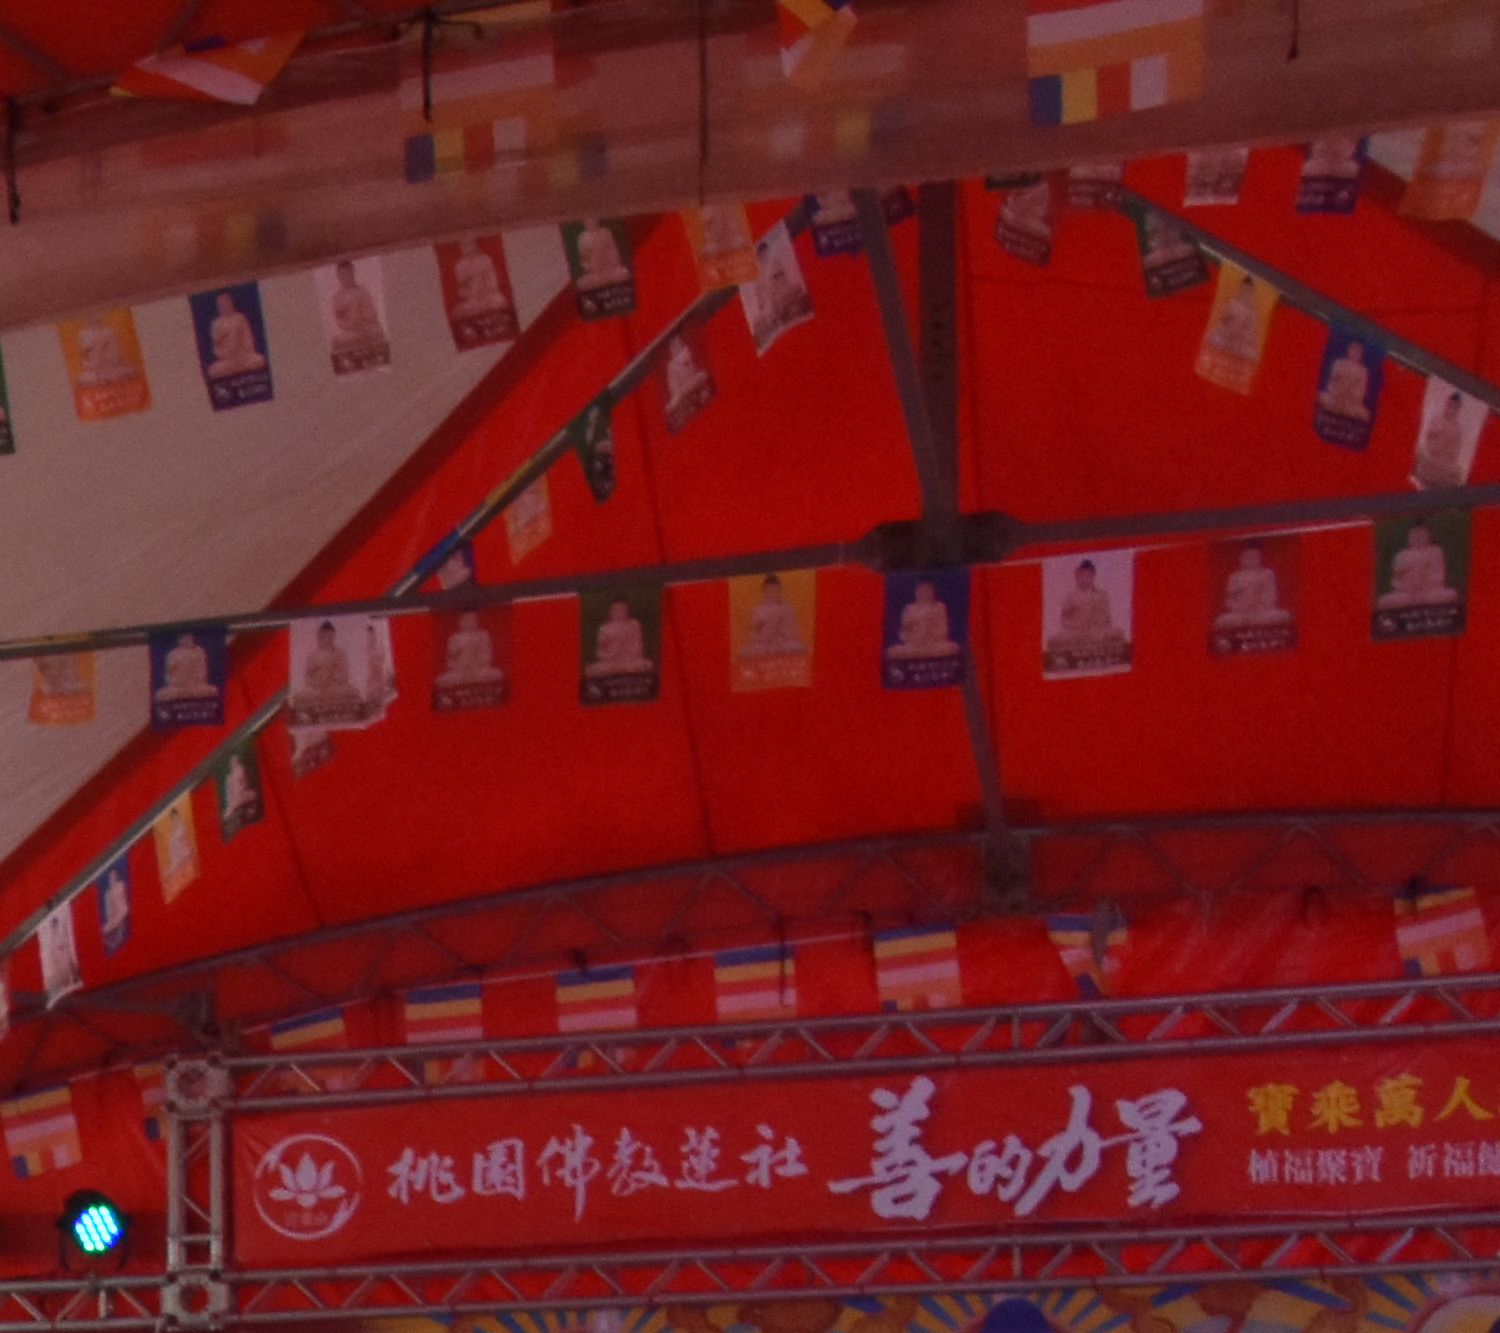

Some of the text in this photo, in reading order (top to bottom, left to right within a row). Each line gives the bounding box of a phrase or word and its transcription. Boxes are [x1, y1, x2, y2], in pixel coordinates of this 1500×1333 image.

[386, 1075, 1203, 1224] 桃園佛教蓮社 善的力量
